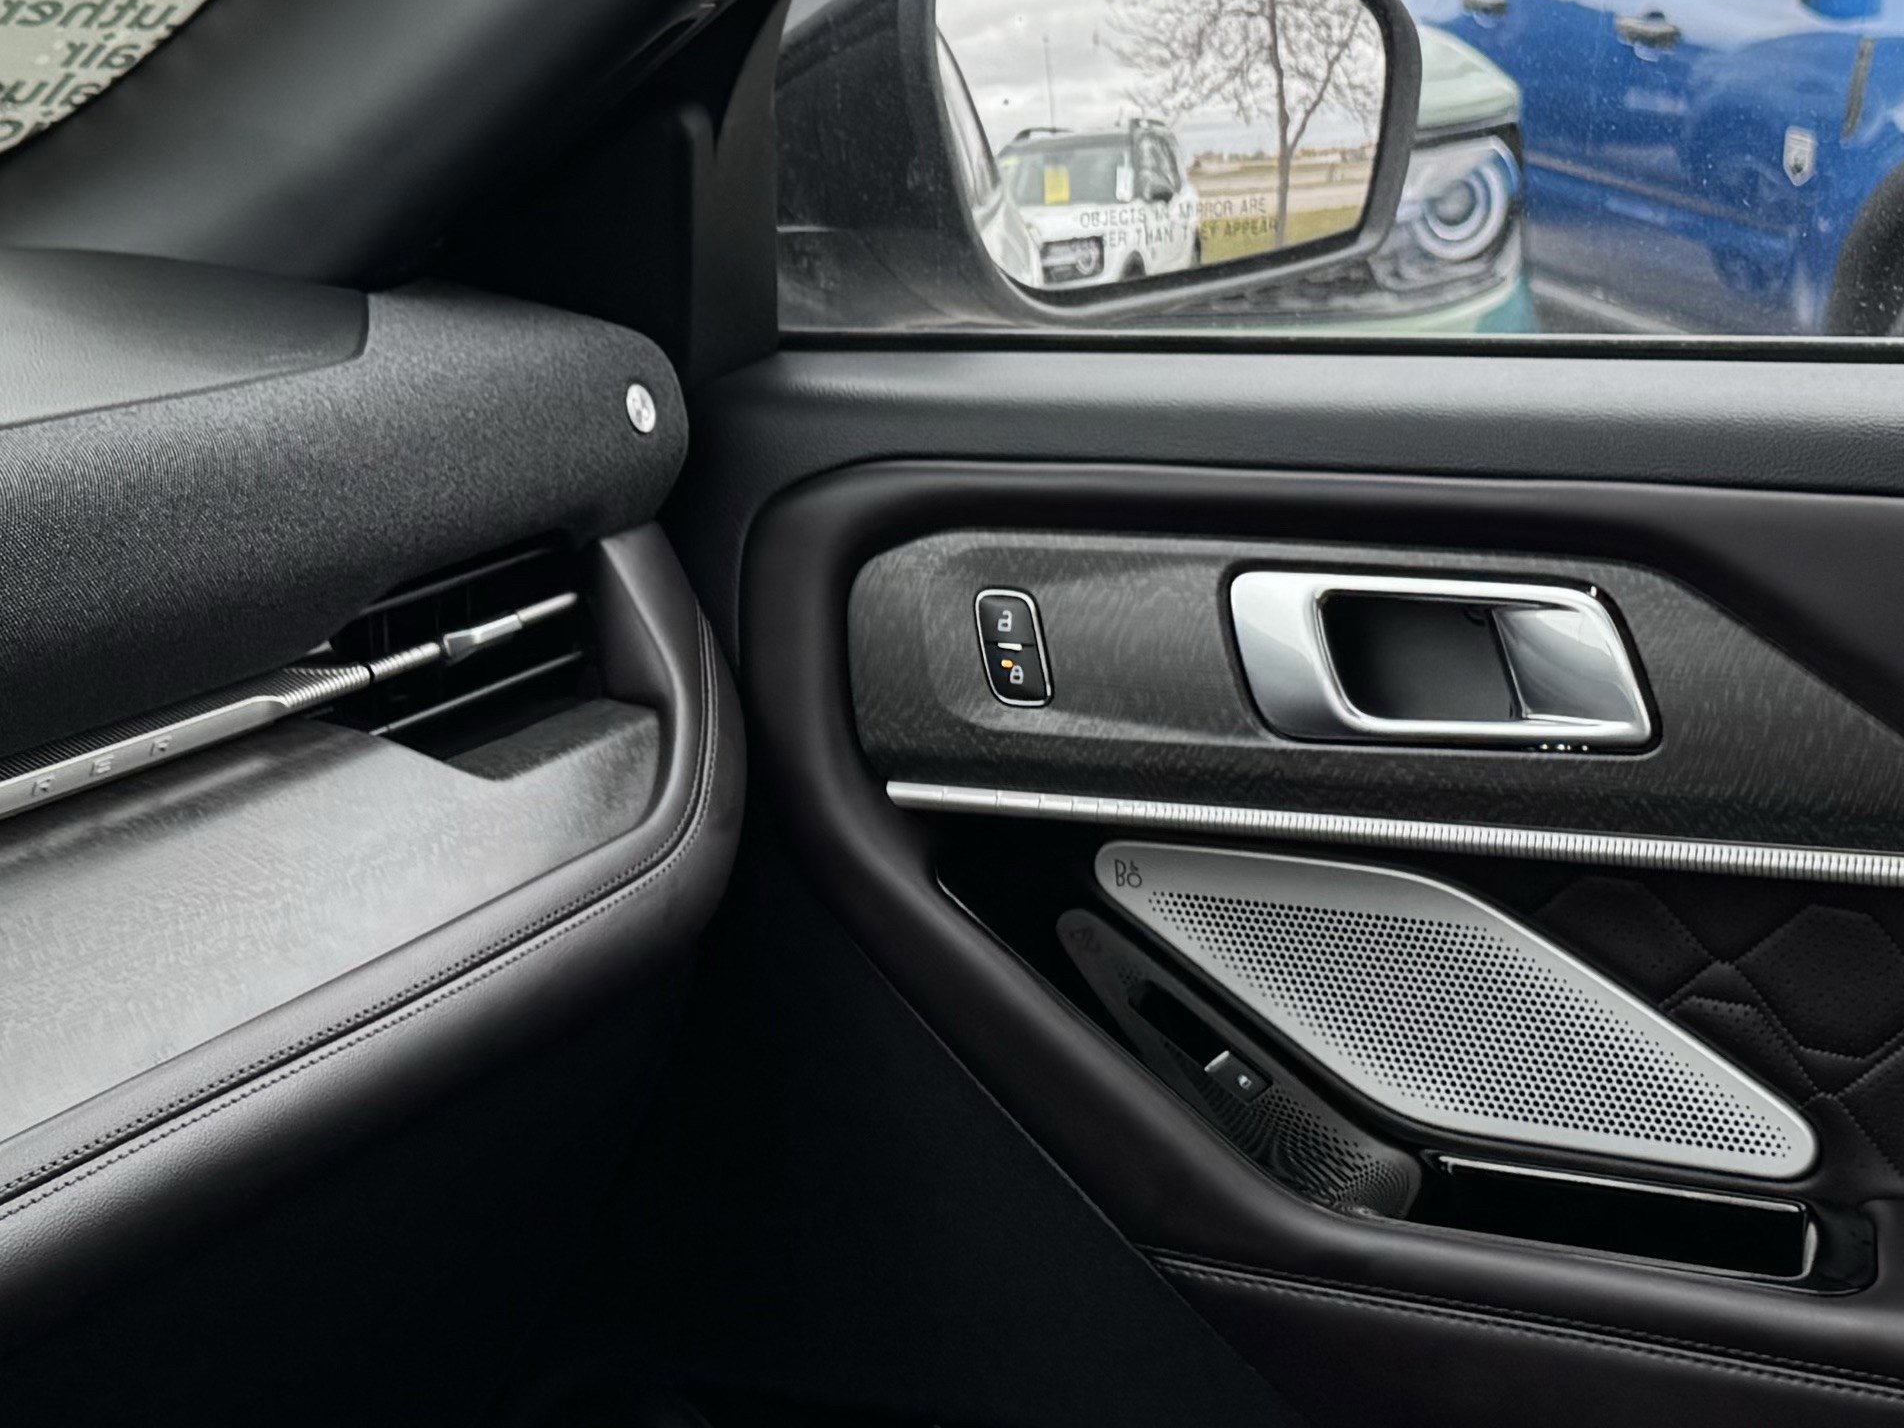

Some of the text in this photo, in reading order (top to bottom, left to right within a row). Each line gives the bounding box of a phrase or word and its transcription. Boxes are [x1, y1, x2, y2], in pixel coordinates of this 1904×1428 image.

[1080, 209, 1146, 228] OBJECTS
[1153, 205, 1169, 220] IN
[1240, 198, 1266, 213] ARE
[1136, 227, 1173, 247] THAN
[1183, 224, 1217, 243] TEY
